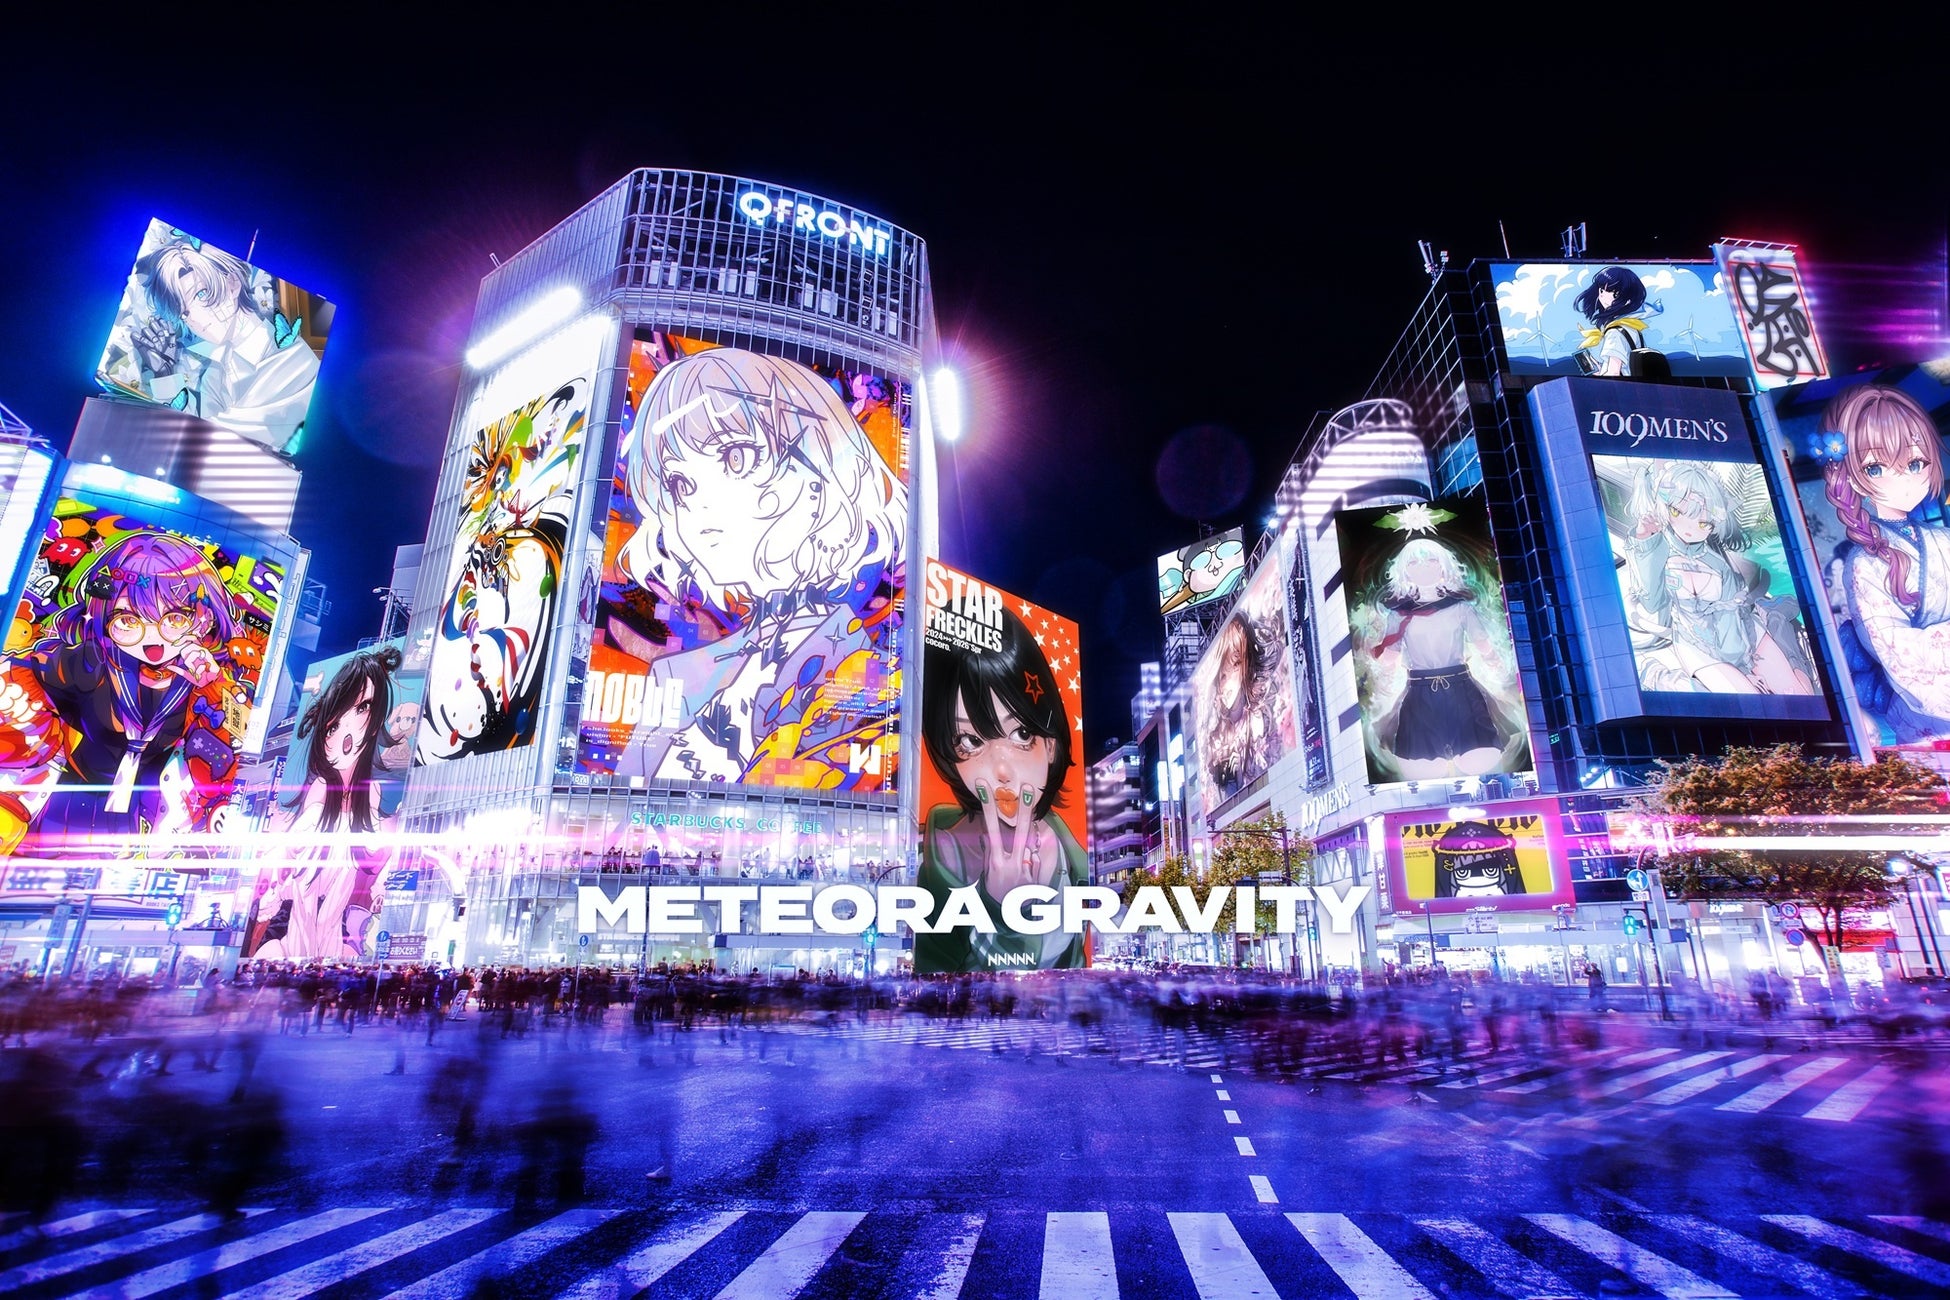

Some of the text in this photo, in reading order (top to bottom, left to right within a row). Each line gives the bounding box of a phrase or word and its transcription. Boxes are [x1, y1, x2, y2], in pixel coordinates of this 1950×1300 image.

[740, 192, 890, 255] QFRONT
[1589, 410, 1728, 448] 109MEN'S
[926, 562, 1004, 632] STAR
[925, 603, 1003, 653] FRECKLES
[925, 636, 951, 653] cocoro.
[631, 812, 822, 835] STARBUCKS COFEE
